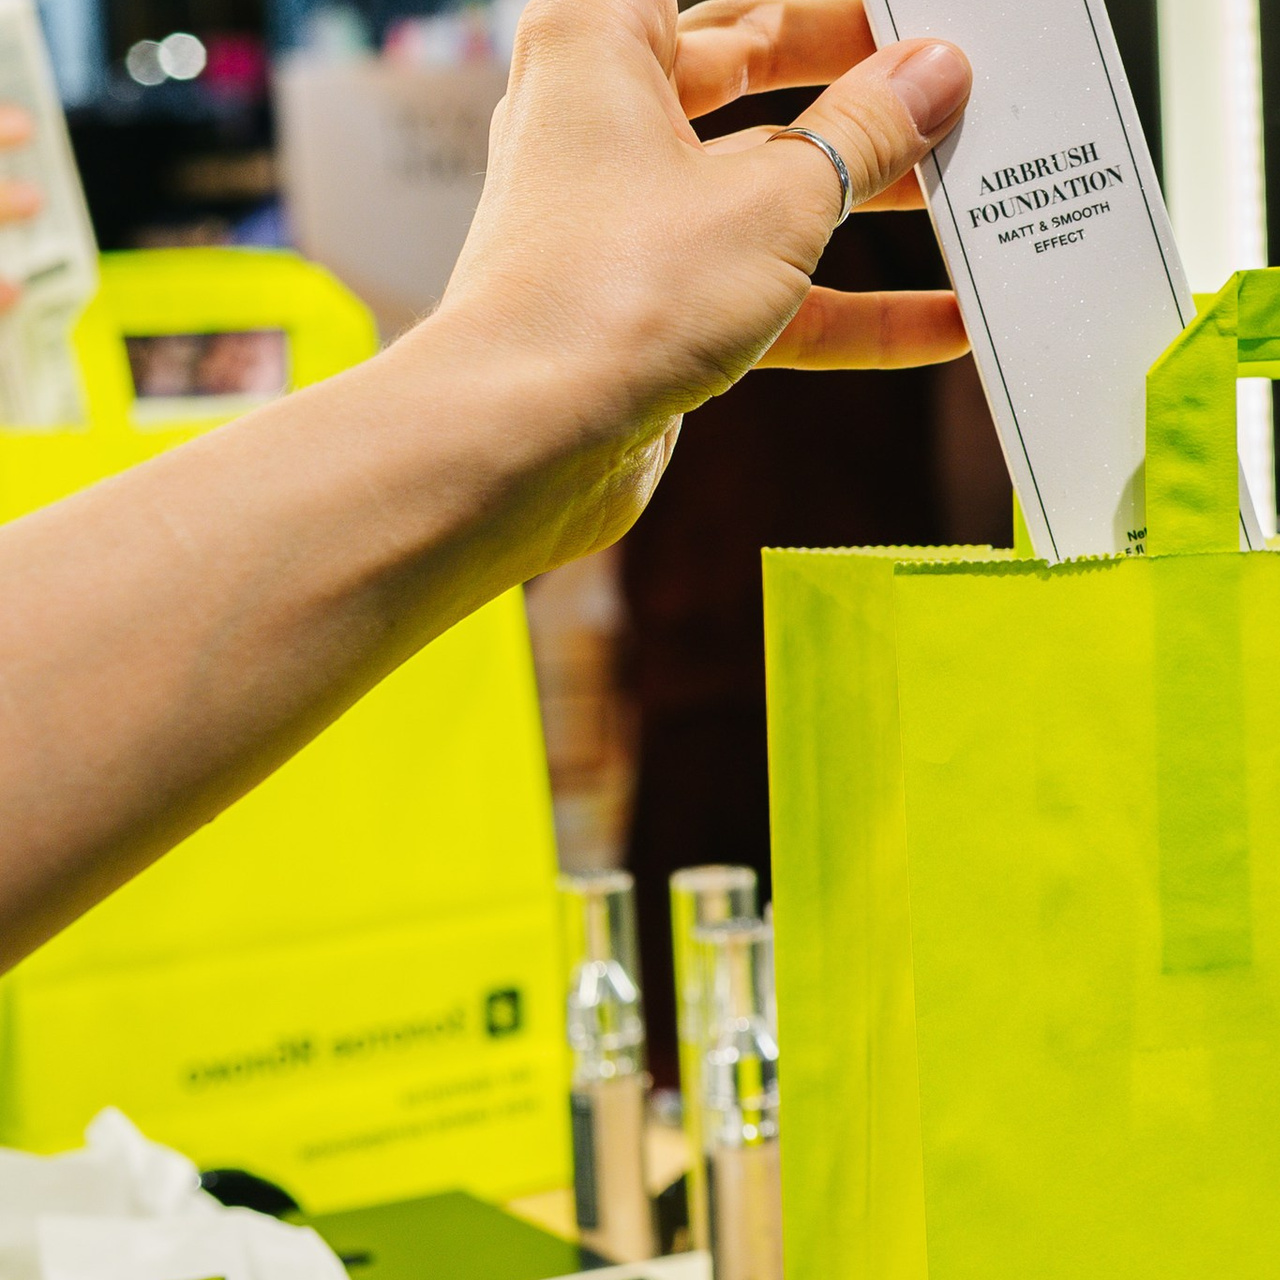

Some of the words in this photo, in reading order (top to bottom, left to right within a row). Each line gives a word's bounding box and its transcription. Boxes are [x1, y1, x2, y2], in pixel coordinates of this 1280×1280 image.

[979, 142, 1100, 196] AIRBRUSH
[967, 165, 1124, 229] FOUNDATION
[998, 224, 1035, 245] MATT
[1039, 221, 1049, 232] &
[1051, 201, 1111, 228] SMOOTH
[1034, 229, 1086, 254] EFFECT
